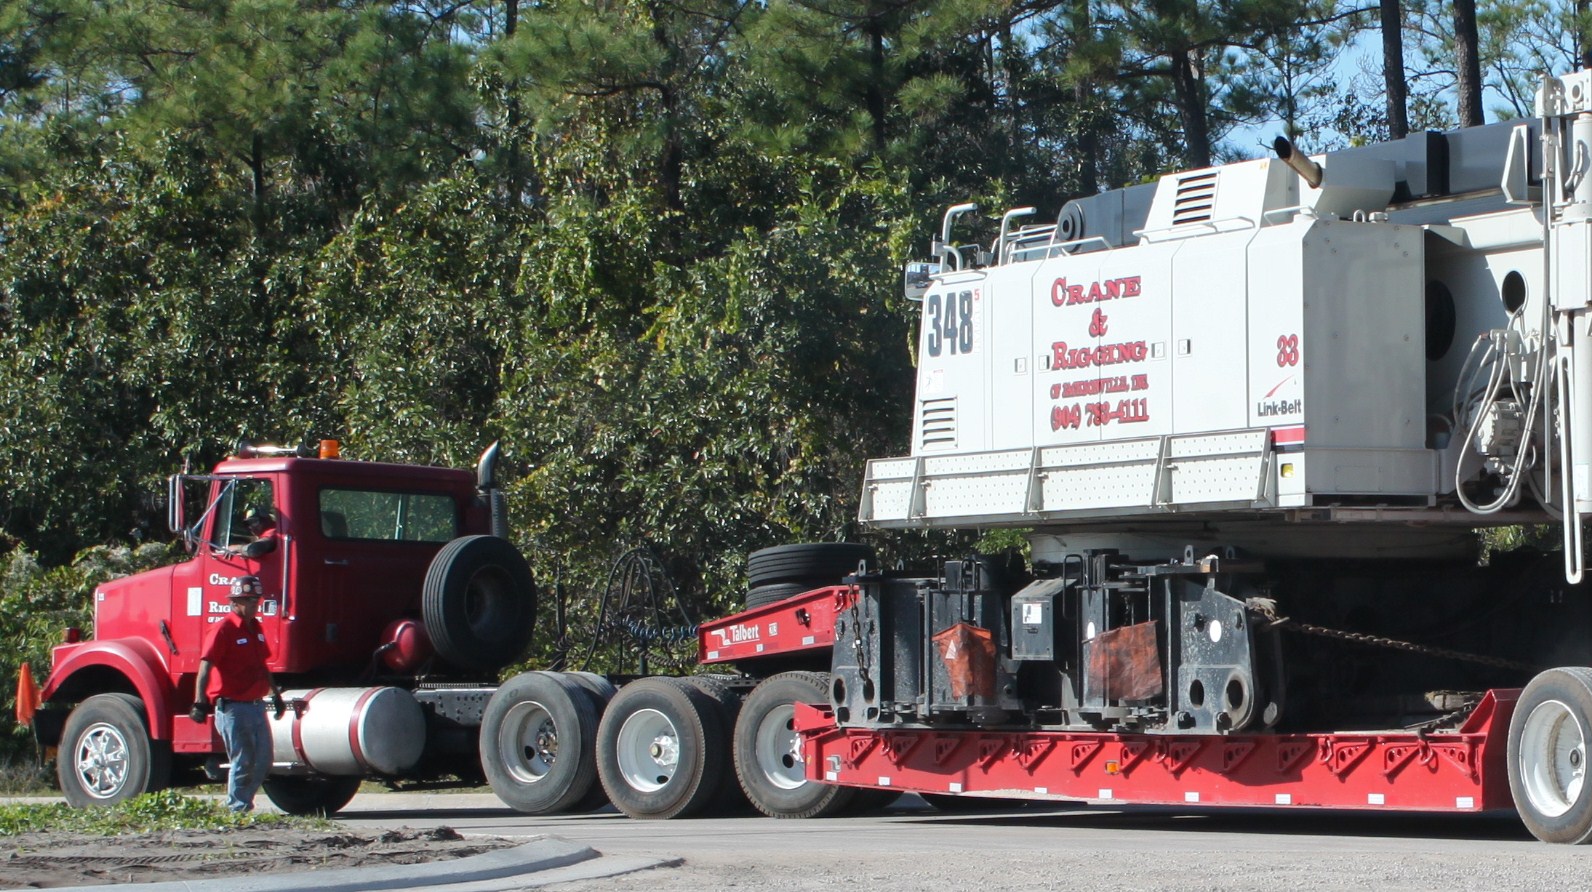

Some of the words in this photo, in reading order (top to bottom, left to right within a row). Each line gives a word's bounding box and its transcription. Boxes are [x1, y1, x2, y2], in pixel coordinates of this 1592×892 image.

[1051, 275, 1141, 307] CRANE
[928, 290, 973, 357] 348
[1088, 308, 1108, 338] &
[1277, 333, 1299, 368] 33
[1257, 399, 1302, 417] Link-Belt
[729, 624, 760, 642] Talbert
